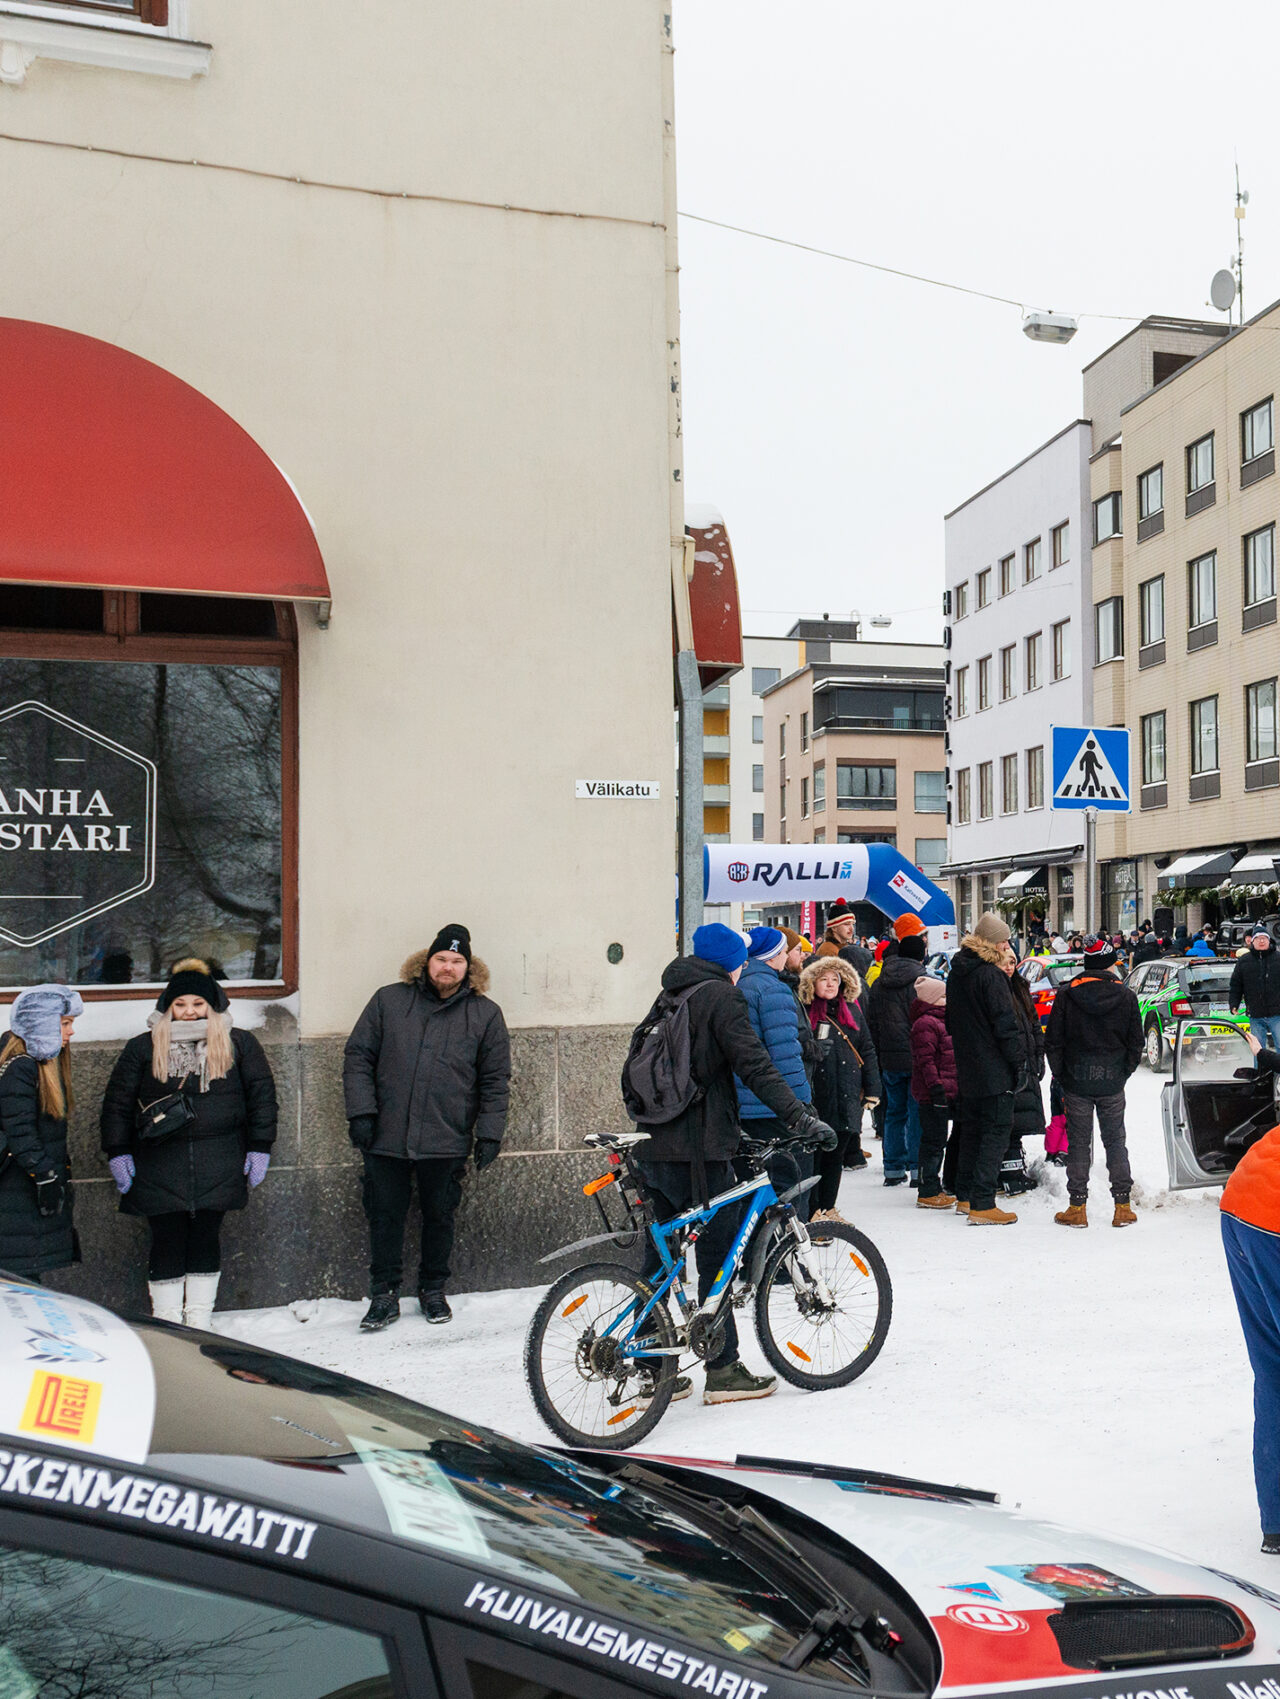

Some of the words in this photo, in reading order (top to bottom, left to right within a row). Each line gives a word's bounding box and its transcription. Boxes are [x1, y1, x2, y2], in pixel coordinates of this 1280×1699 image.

[585, 782, 651, 797] Välikatu
[752, 861, 840, 887] RALLI
[1024, 886, 1047, 894] HOTEL
[34, 1375, 90, 1437] PIRELLI
[464, 1581, 768, 1699] KUIVAUSMESTARIT
